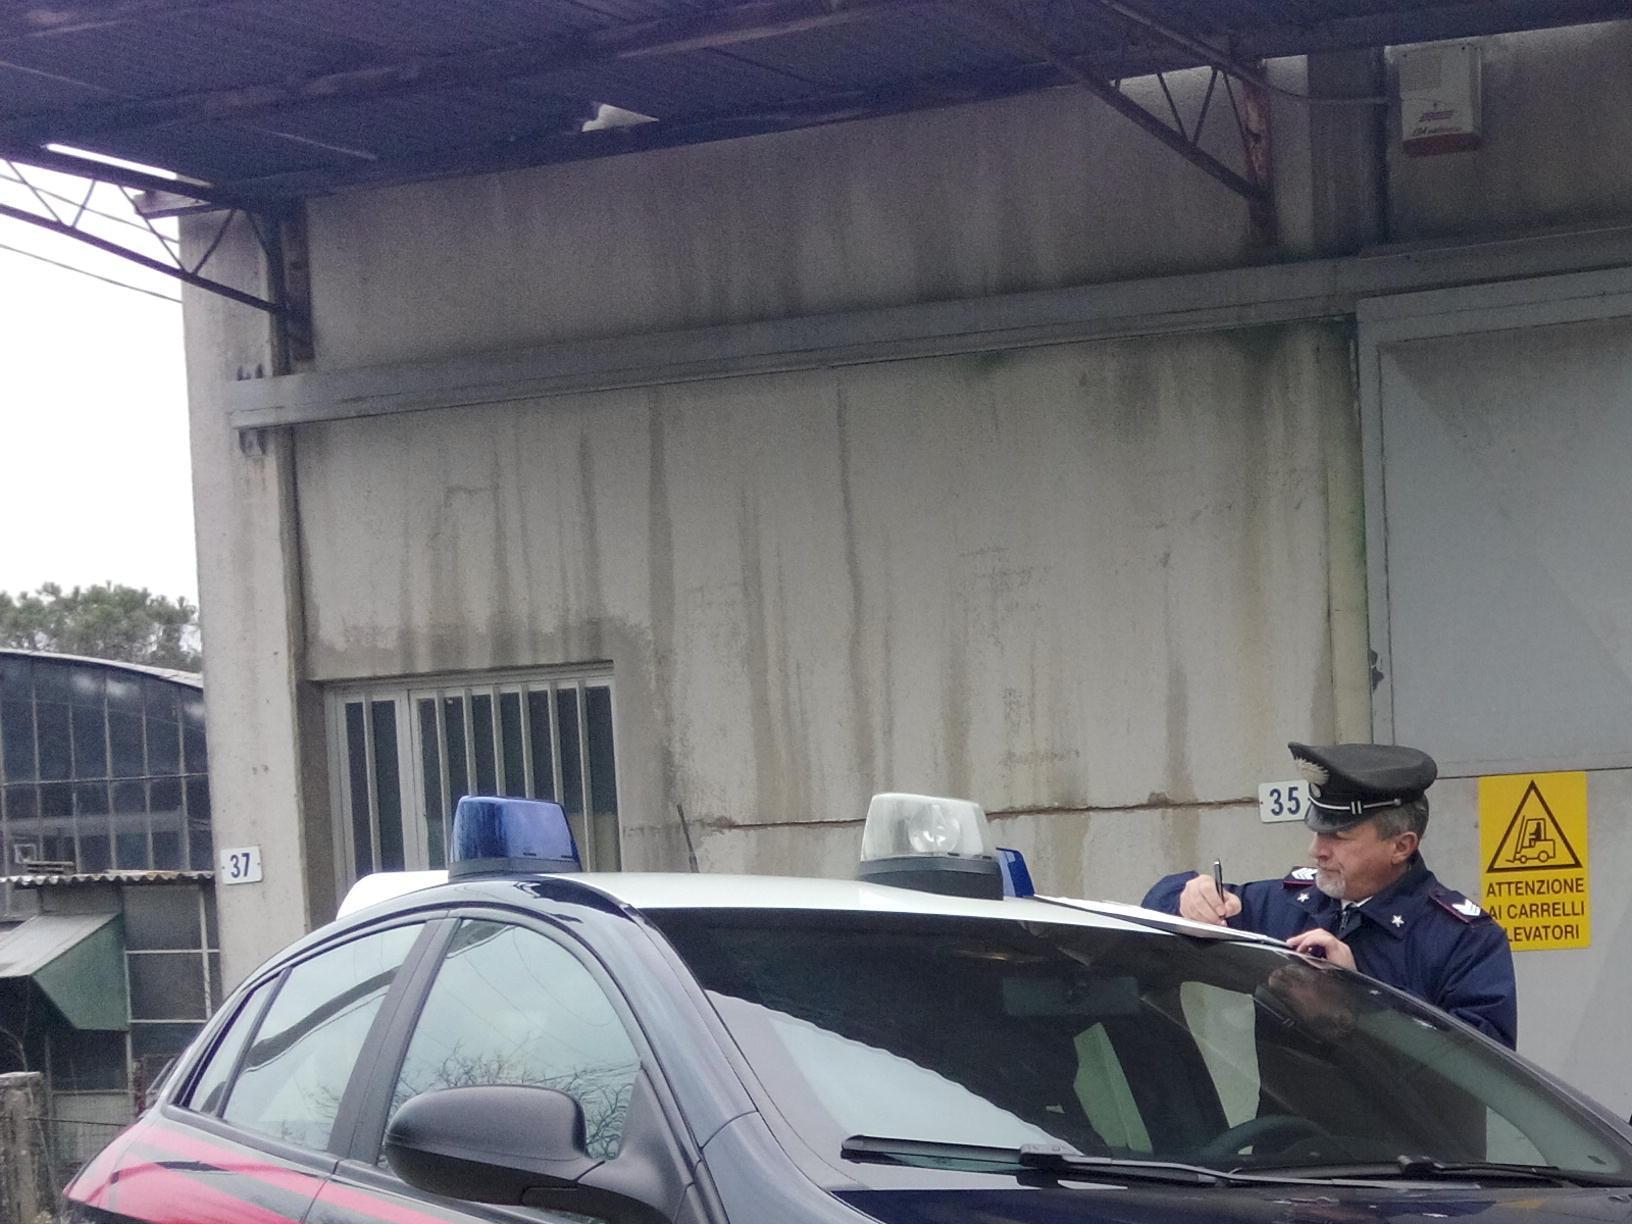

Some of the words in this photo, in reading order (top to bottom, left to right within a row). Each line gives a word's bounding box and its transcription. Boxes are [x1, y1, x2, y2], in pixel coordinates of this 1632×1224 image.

[1269, 786, 1301, 816] 35
[229, 852, 251, 878] 37
[1486, 877, 1585, 897] ATTENZIONE
[1489, 905, 1502, 920] AI
[1507, 901, 1585, 920] CARRELLI
[1504, 924, 1580, 942] LEVATORI
